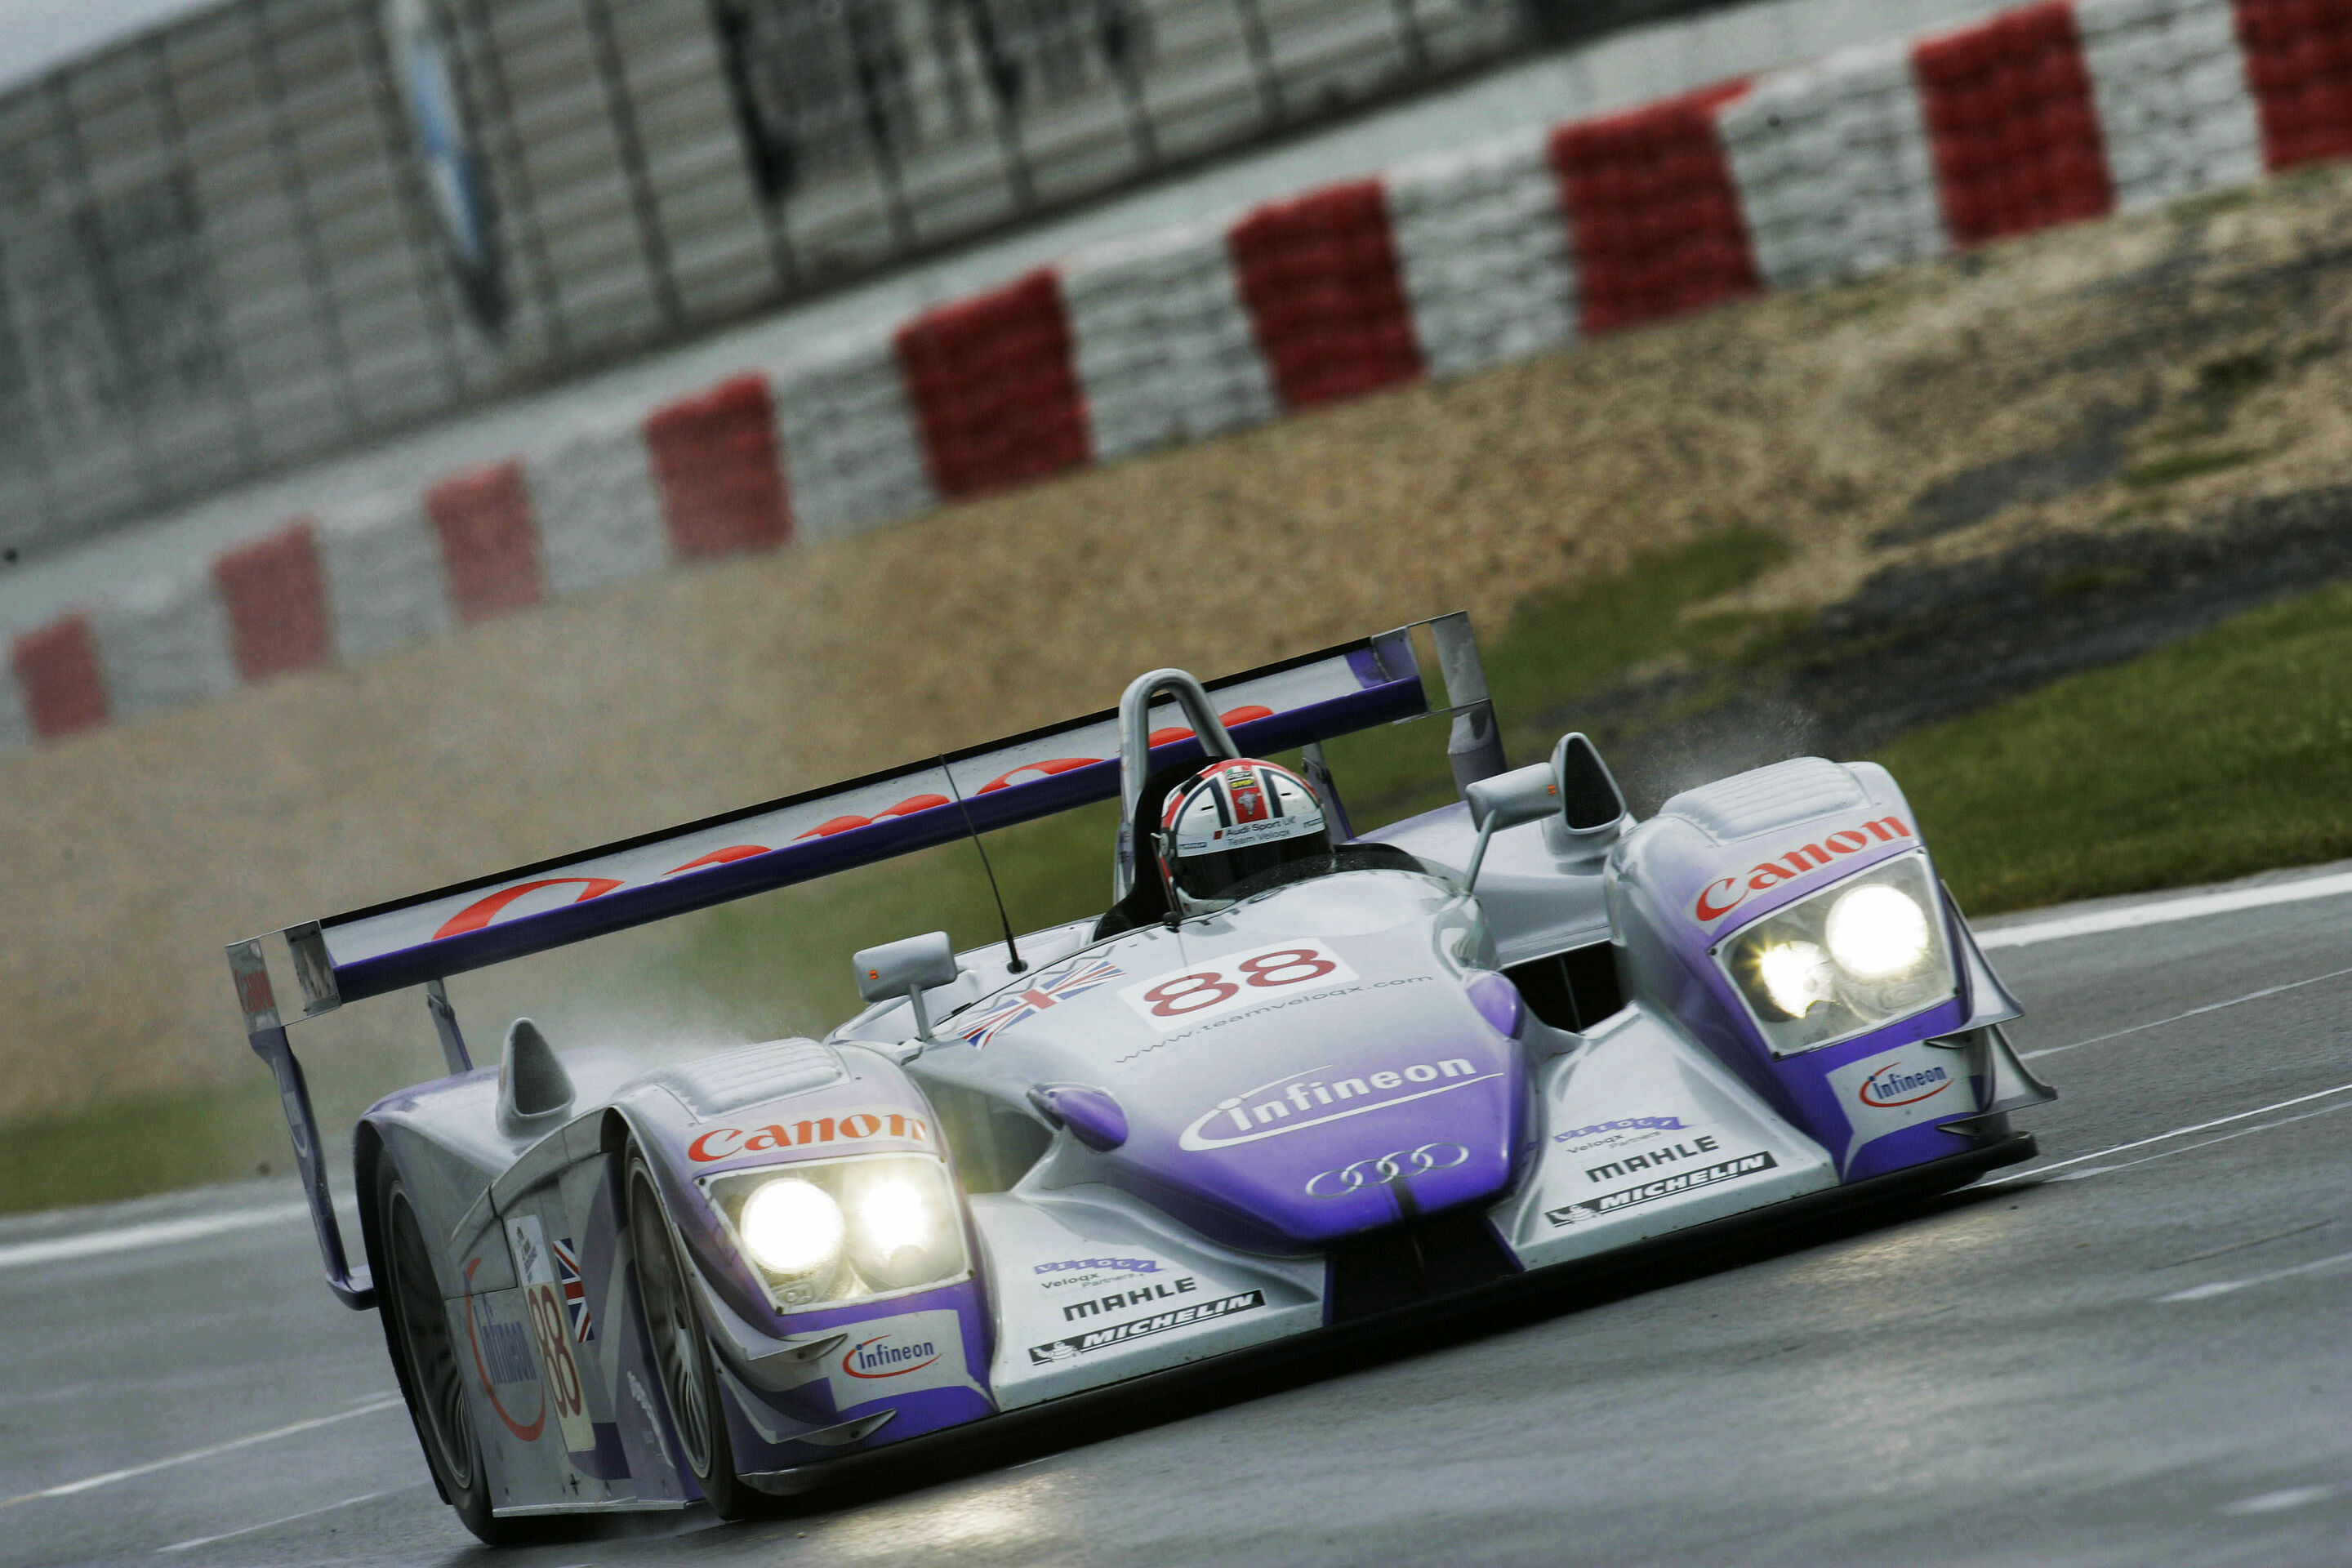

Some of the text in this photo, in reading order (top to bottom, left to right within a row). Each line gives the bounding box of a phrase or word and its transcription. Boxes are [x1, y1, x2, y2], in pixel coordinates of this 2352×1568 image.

[1226, 826, 1250, 836] Audi
[1252, 820, 1281, 831] Sport
[1695, 816, 1913, 922] Canon
[1143, 947, 1338, 1018] 88
[1114, 974, 1433, 1063] www.teamveloqx.com
[688, 1113, 927, 1163] Canon
[1586, 1134, 1720, 1183] MAHLE
[1599, 1155, 1767, 1210] MICHELIN
[1040, 1272, 1100, 1290] Veloqx
[1063, 1276, 1198, 1322] MAHLE
[1081, 1292, 1256, 1349] MICHELIN
[528, 1285, 582, 1419] 88
